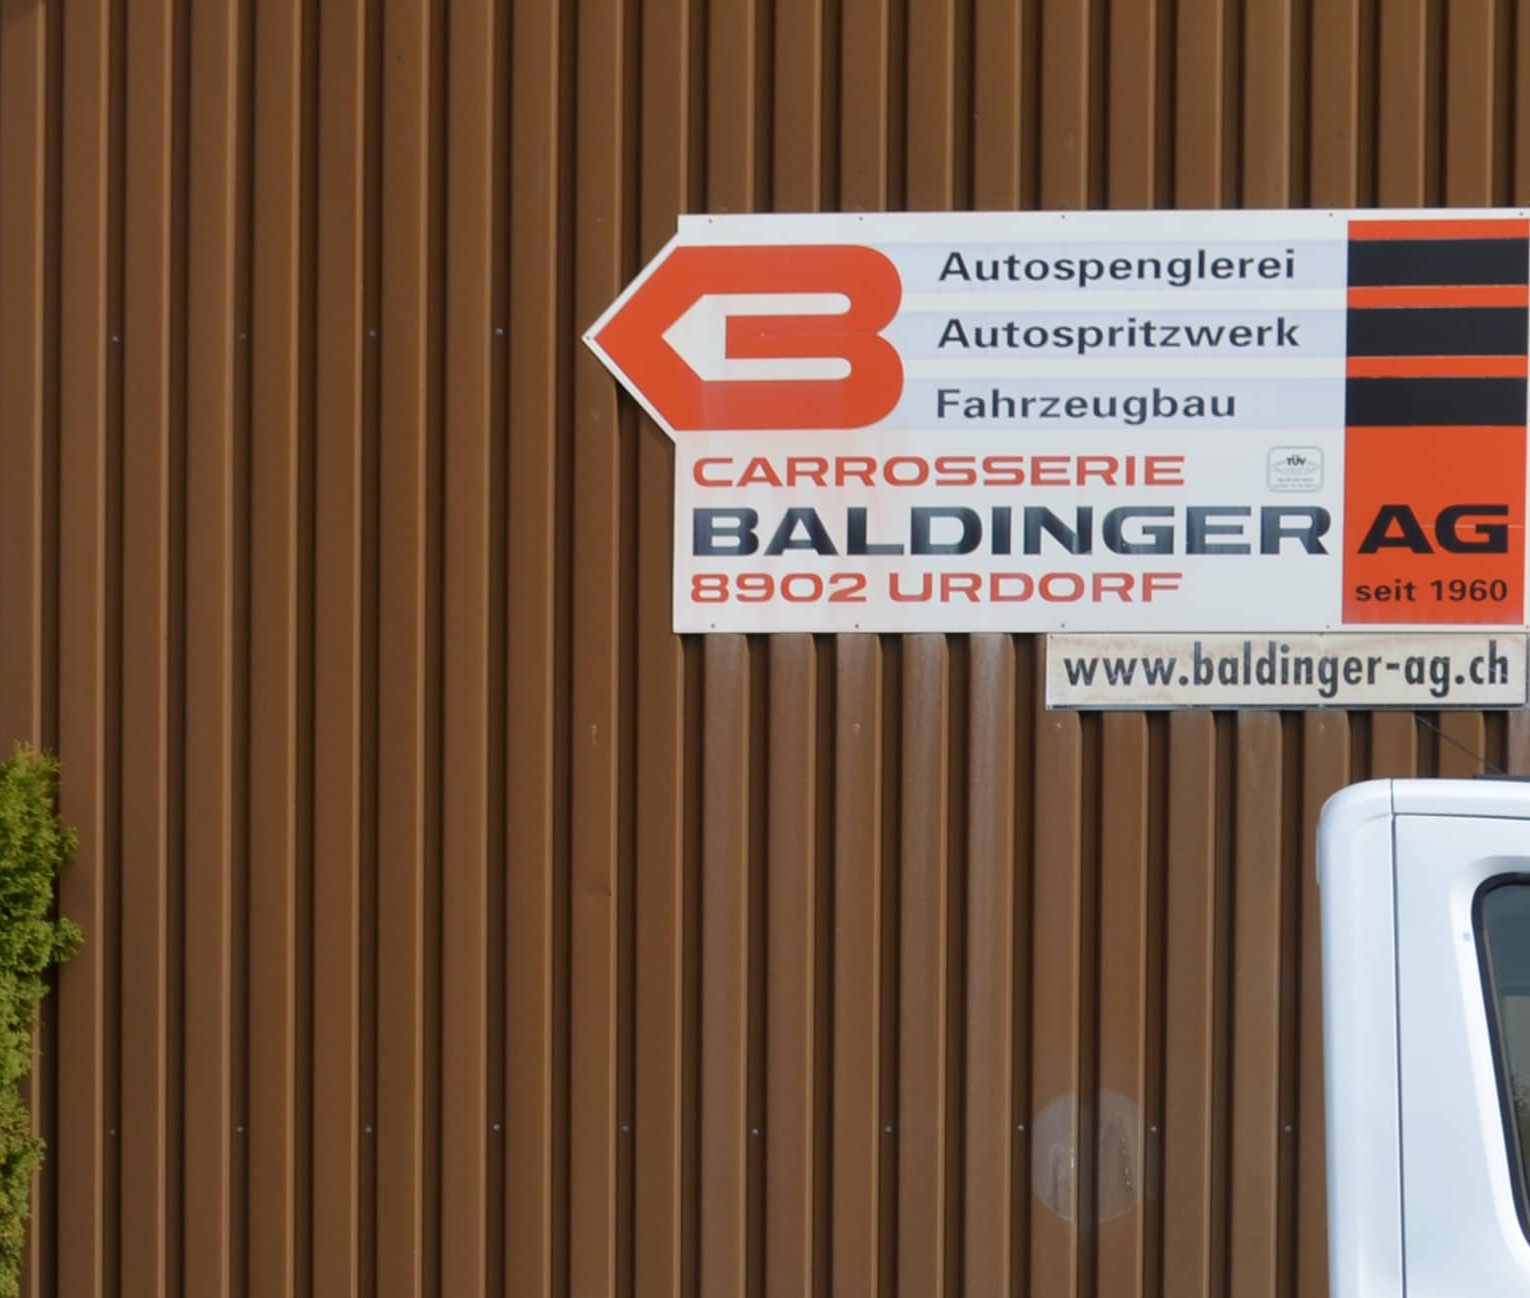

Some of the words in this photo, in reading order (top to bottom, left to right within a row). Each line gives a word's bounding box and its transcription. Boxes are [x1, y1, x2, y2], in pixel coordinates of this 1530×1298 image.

[938, 247, 1295, 289] Autospenglerei
[937, 316, 1300, 356] Autospritzwerk
[936, 386, 1236, 426] Fahrzeugbau
[692, 455, 1185, 488] CARROSSERIE
[691, 505, 1332, 557] BALDINGER
[1356, 503, 1510, 556] AG
[690, 572, 868, 604] 8902
[888, 571, 1183, 603] URDORF
[1354, 577, 1417, 603] seit
[1429, 578, 1509, 603] 1960
[1062, 639, 1510, 699] www.baldinger-ag.ch
